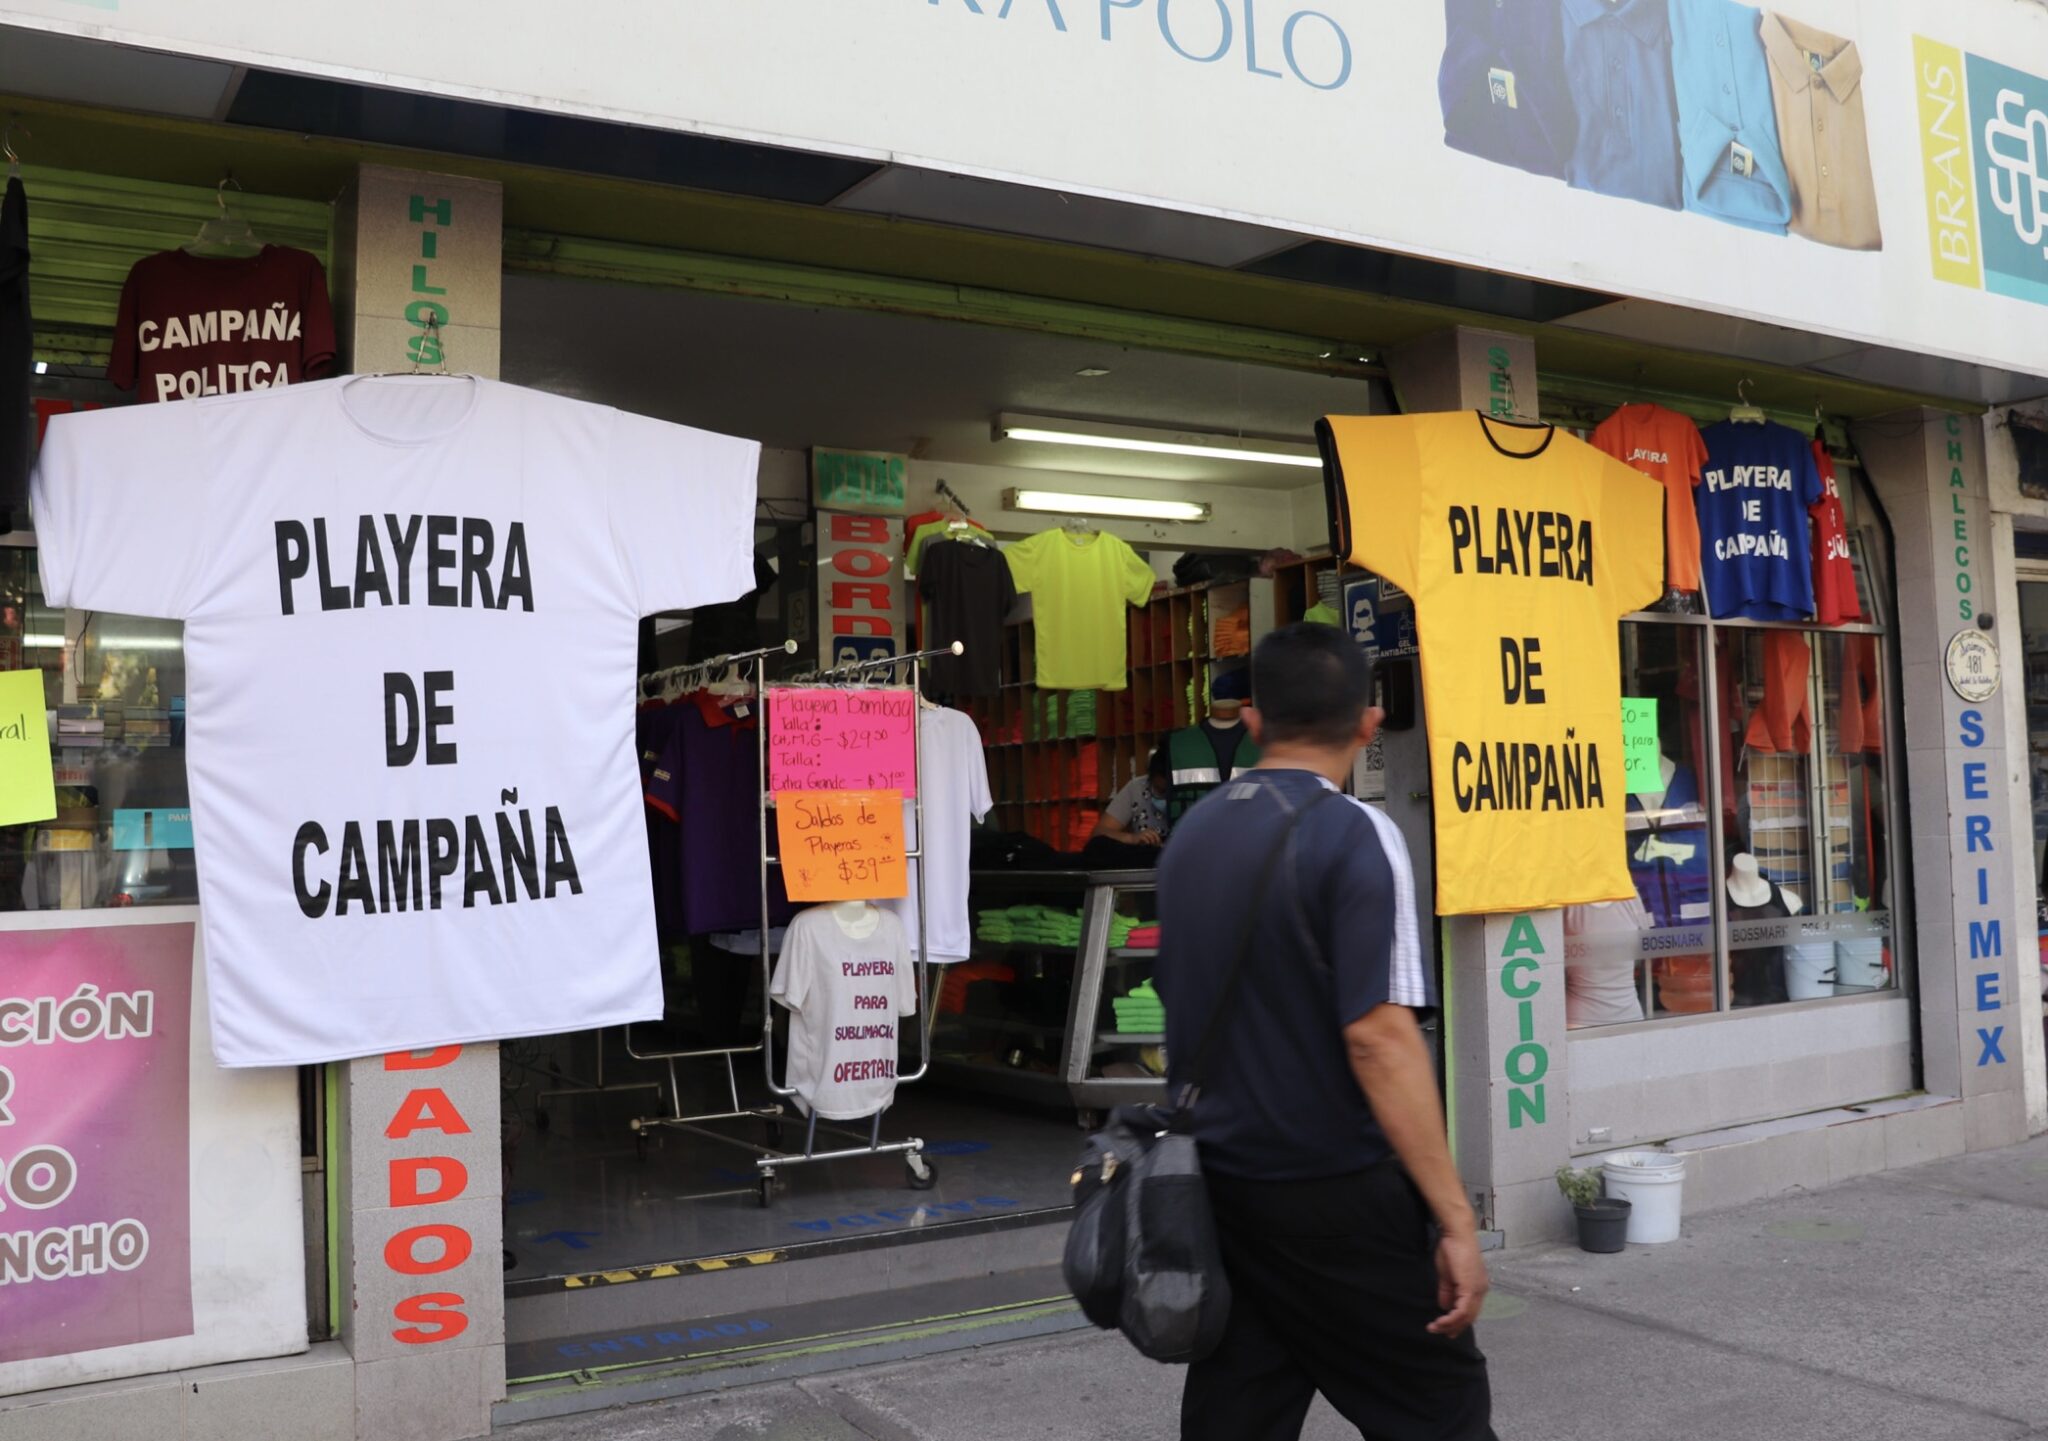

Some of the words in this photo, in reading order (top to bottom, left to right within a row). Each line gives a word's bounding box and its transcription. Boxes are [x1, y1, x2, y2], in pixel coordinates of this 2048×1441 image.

[1923, 61, 1970, 264] BRANS
[405, 195, 452, 365] HILOS
[138, 301, 301, 352] CAMPAÑA
[155, 361, 289, 403] POLITCA
[1705, 465, 1792, 493] PLAYERA
[1449, 505, 1593, 586] PLAYERA
[1946, 416, 1973, 620] CHALECOS
[274, 513, 534, 615] PLAYERA
[1500, 637, 1545, 705] DE
[1966, 655, 1982, 673] 481
[383, 671, 457, 767] DE
[777, 689, 838, 722] Playera
[1452, 727, 1604, 813] CAMPAÑA
[795, 799, 844, 830] Saldos
[857, 801, 877, 824] de
[804, 835, 862, 857] Playeras
[292, 787, 583, 919] CAMPAÑA
[1959, 710, 2007, 1066] SERIMEX
[842, 960, 894, 977] PLAYERA
[1642, 932, 1704, 951] BOSSMARK
[0, 982, 153, 1047] CIÓN
[854, 995, 888, 1010] PARA
[1500, 915, 1549, 1129] ACION
[834, 1059, 895, 1083] OFERTA!!
[0, 1218, 149, 1284] NCHO
[556, 1317, 773, 1357] ENTRADA
